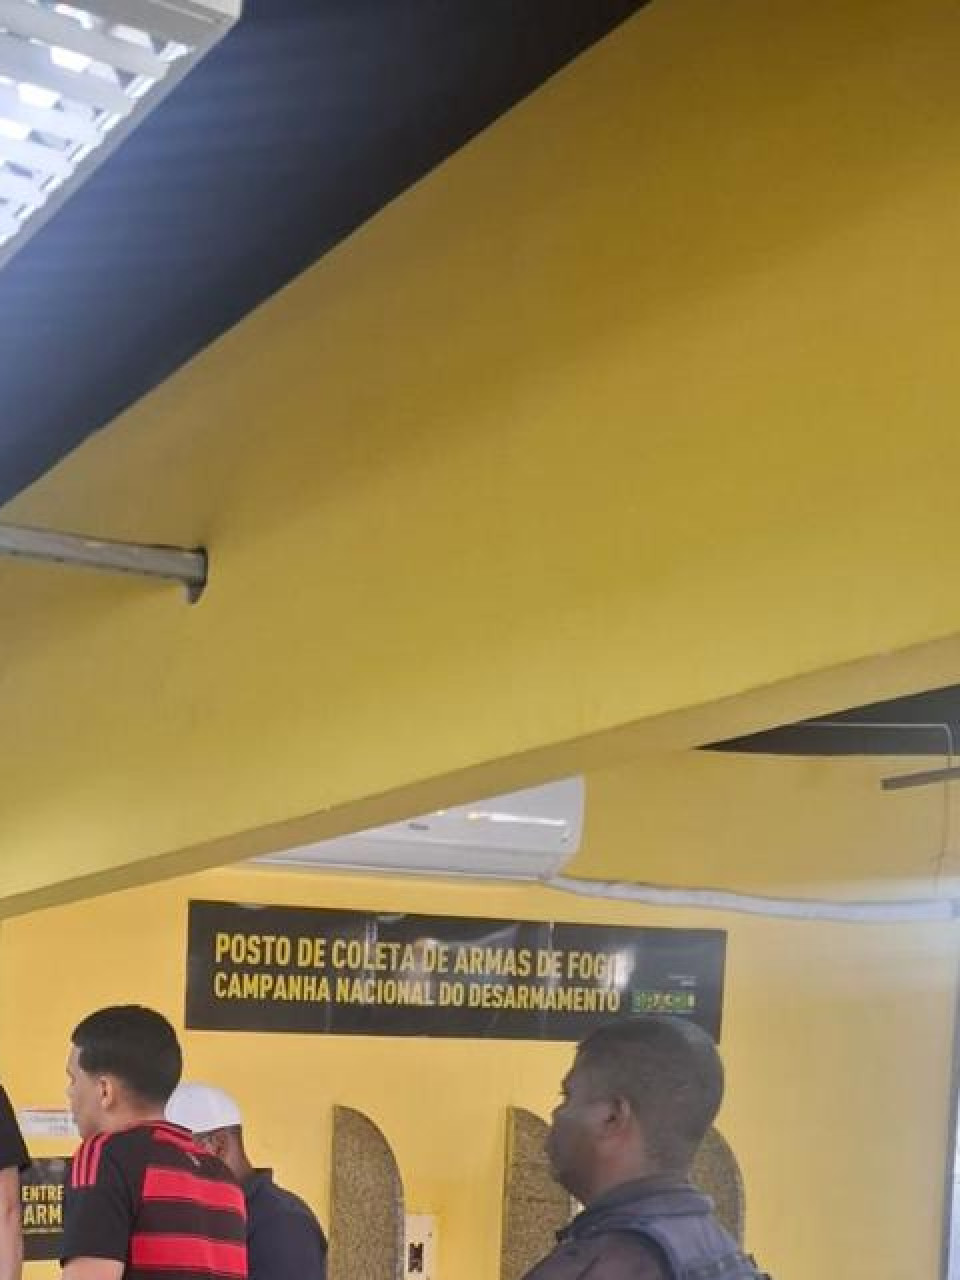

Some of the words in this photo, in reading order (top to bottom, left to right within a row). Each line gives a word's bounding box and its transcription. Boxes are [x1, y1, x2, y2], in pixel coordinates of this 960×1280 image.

[214, 931, 291, 967] POSTO
[296, 937, 327, 969] DE
[331, 939, 416, 972] COLETA
[423, 943, 449, 973] DE
[454, 946, 531, 977] ARMAS
[537, 950, 564, 978] DE
[214, 971, 331, 1002] CAMPANHA
[336, 976, 436, 1006] NACIONAL
[439, 981, 465, 1007] DO
[468, 984, 621, 1013] DESARMAMENTO
